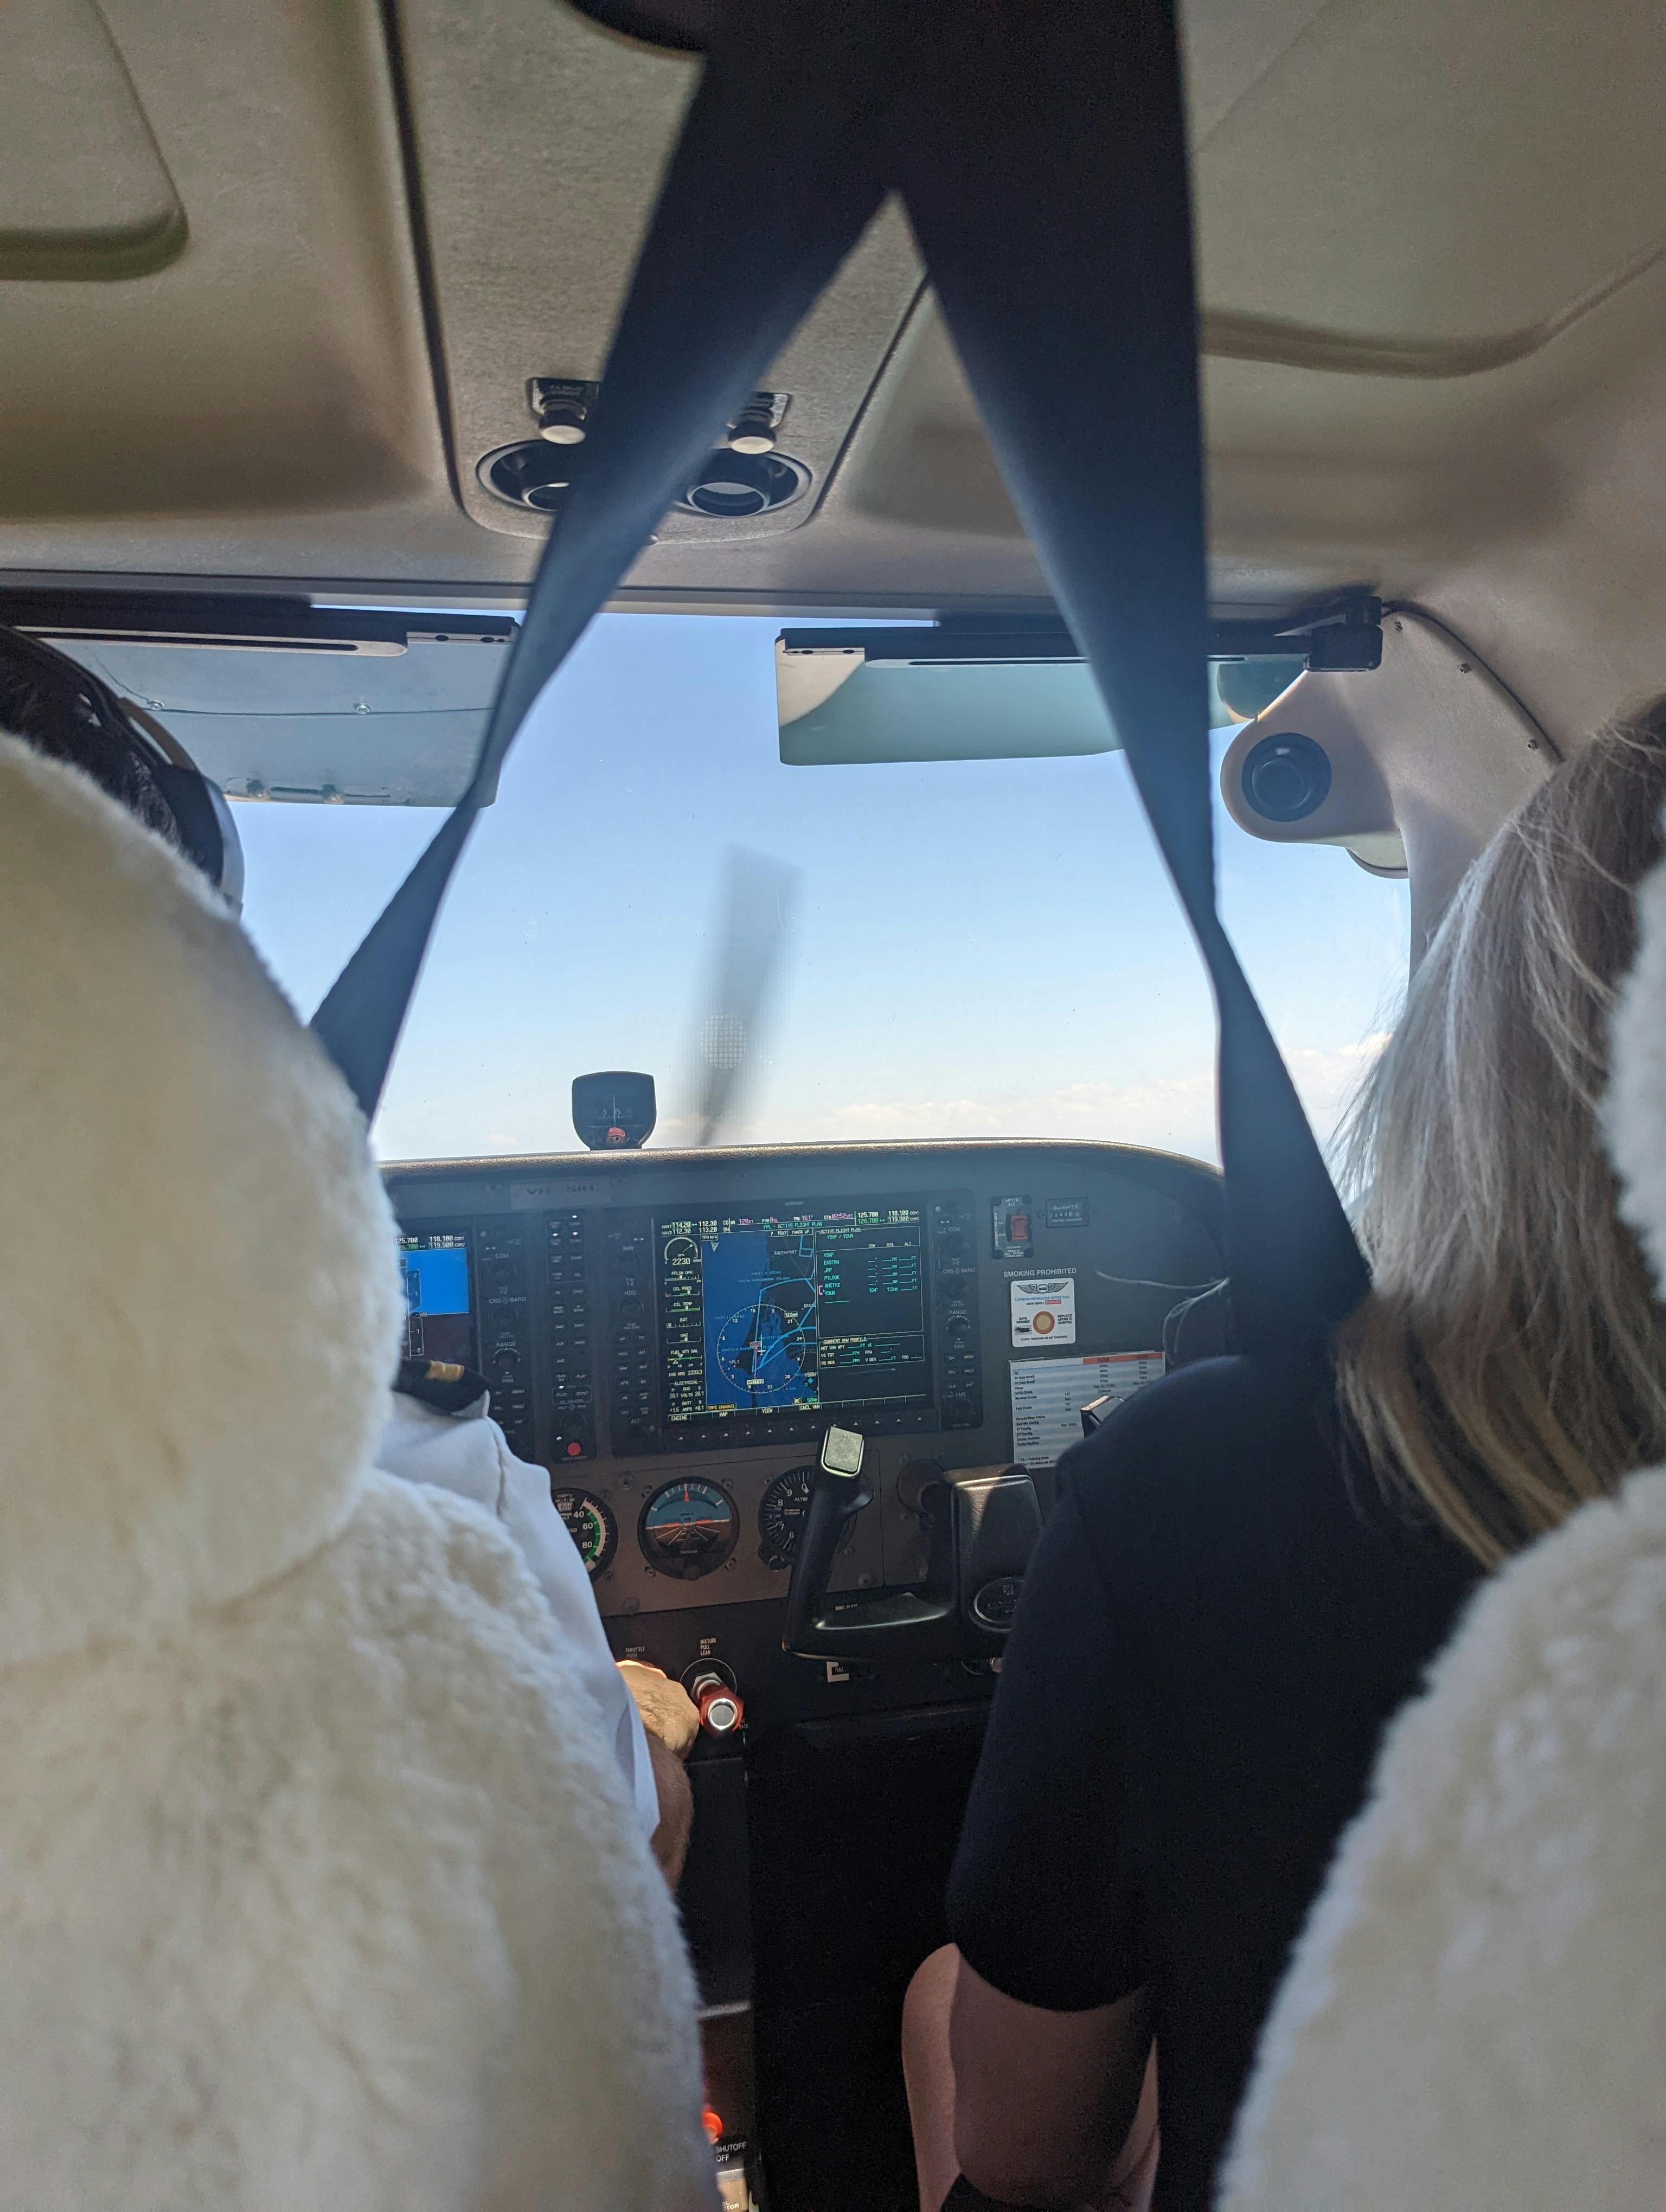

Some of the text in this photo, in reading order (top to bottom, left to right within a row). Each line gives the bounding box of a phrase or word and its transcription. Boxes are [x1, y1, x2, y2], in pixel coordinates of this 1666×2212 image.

[1036, 1268, 1077, 1276] PROHIBITED
[715, 2142, 747, 2153] SHUTOFF
[716, 2153, 730, 2163] OFF
